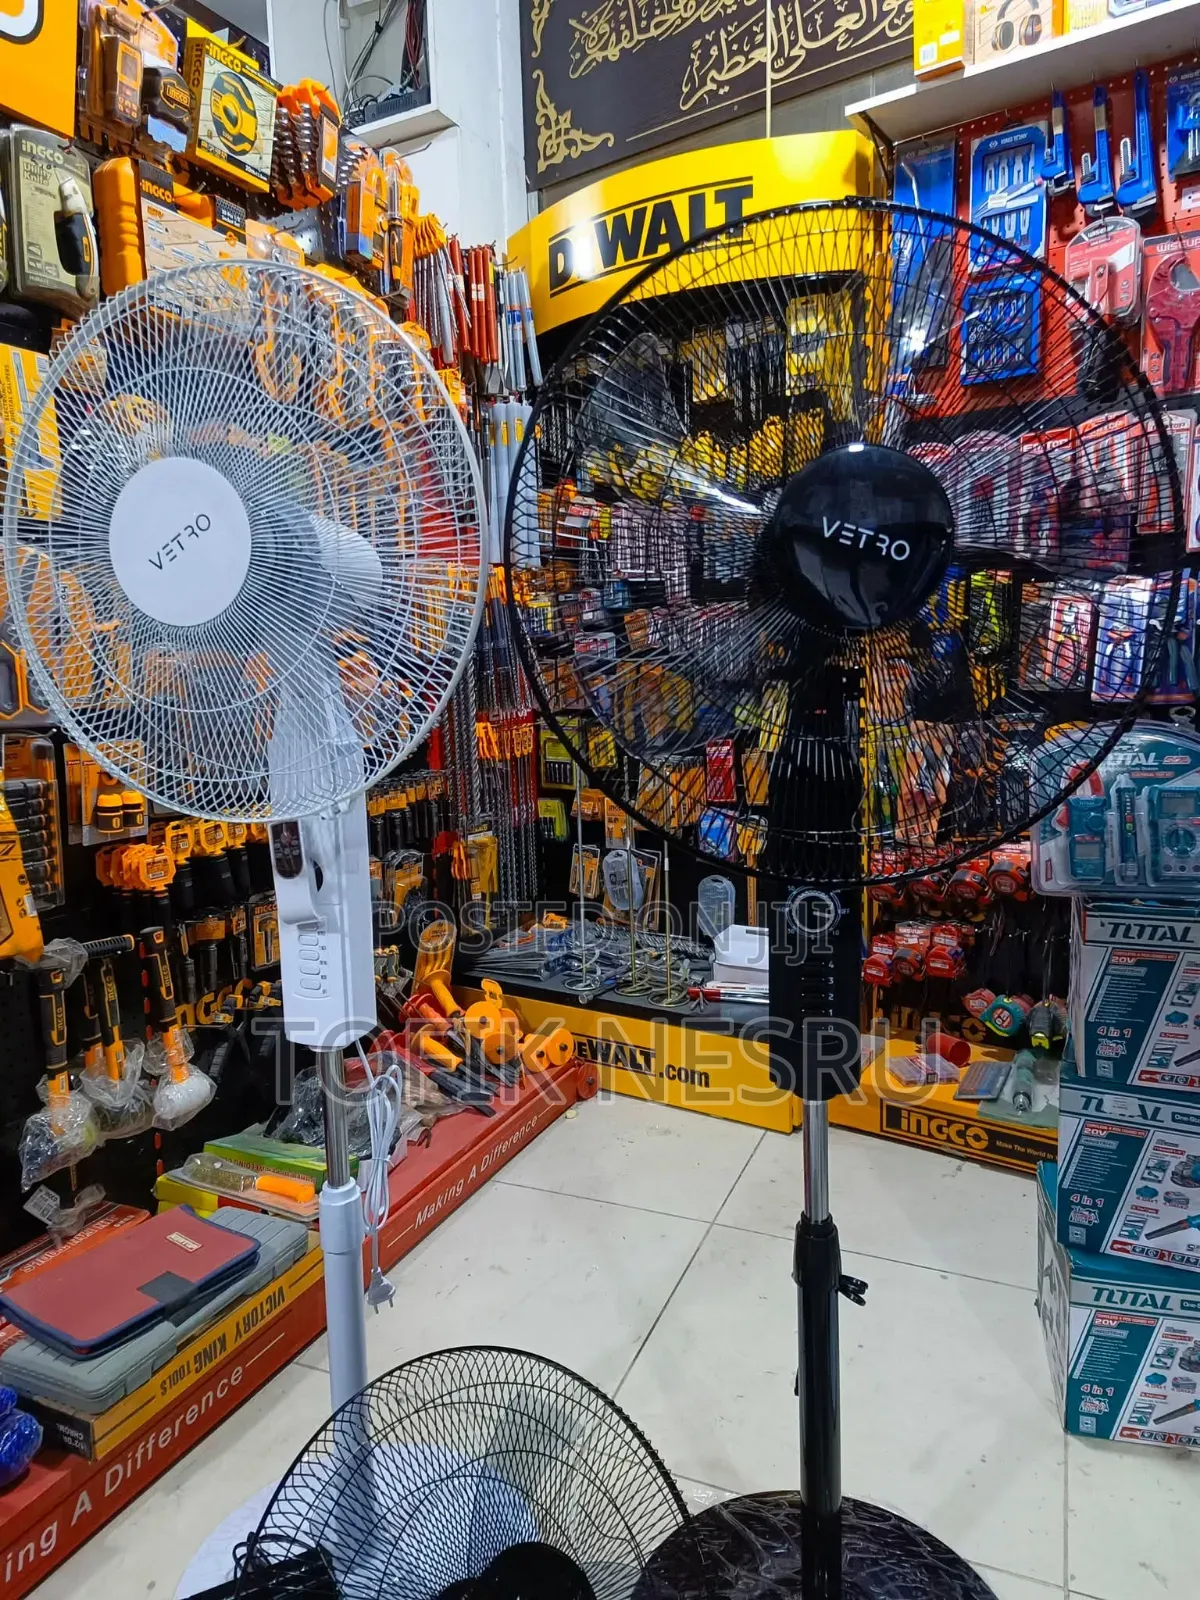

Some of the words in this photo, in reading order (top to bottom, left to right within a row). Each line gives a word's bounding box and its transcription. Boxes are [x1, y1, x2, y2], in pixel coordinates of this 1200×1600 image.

[550, 184, 754, 291] DWALT
[149, 514, 211, 570] VETRO
[823, 516, 910, 561] VETRO
[1104, 921, 1195, 943] TOTAL
[1111, 956, 1136, 964] 20V
[828, 976, 834, 985] 3
[828, 993, 834, 1001] 2
[1097, 1025, 1106, 1035] 4
[1108, 1026, 1120, 1037] in
[1123, 1028, 1132, 1038] 1
[1084, 1127, 1107, 1136] 20V
[415, 1179, 464, 1230] Making
[468, 1167, 476, 1185] A
[480, 1116, 538, 1172] Difference
[1070, 1193, 1080, 1203] 4
[1081, 1195, 1092, 1206] in
[1095, 1198, 1104, 1207] 1
[1092, 1286, 1174, 1311] TOTAL
[233, 1286, 286, 1342] VICTORY
[1094, 1319, 1117, 1327] 20V
[194, 1332, 227, 1374] KING
[159, 1360, 191, 1395] TOOLS
[1080, 1383, 1091, 1393] 4
[1092, 1385, 1103, 1395] in
[1106, 1387, 1114, 1396] 1
[71, 1495, 93, 1527] A
[104, 1365, 244, 1498] Difference
